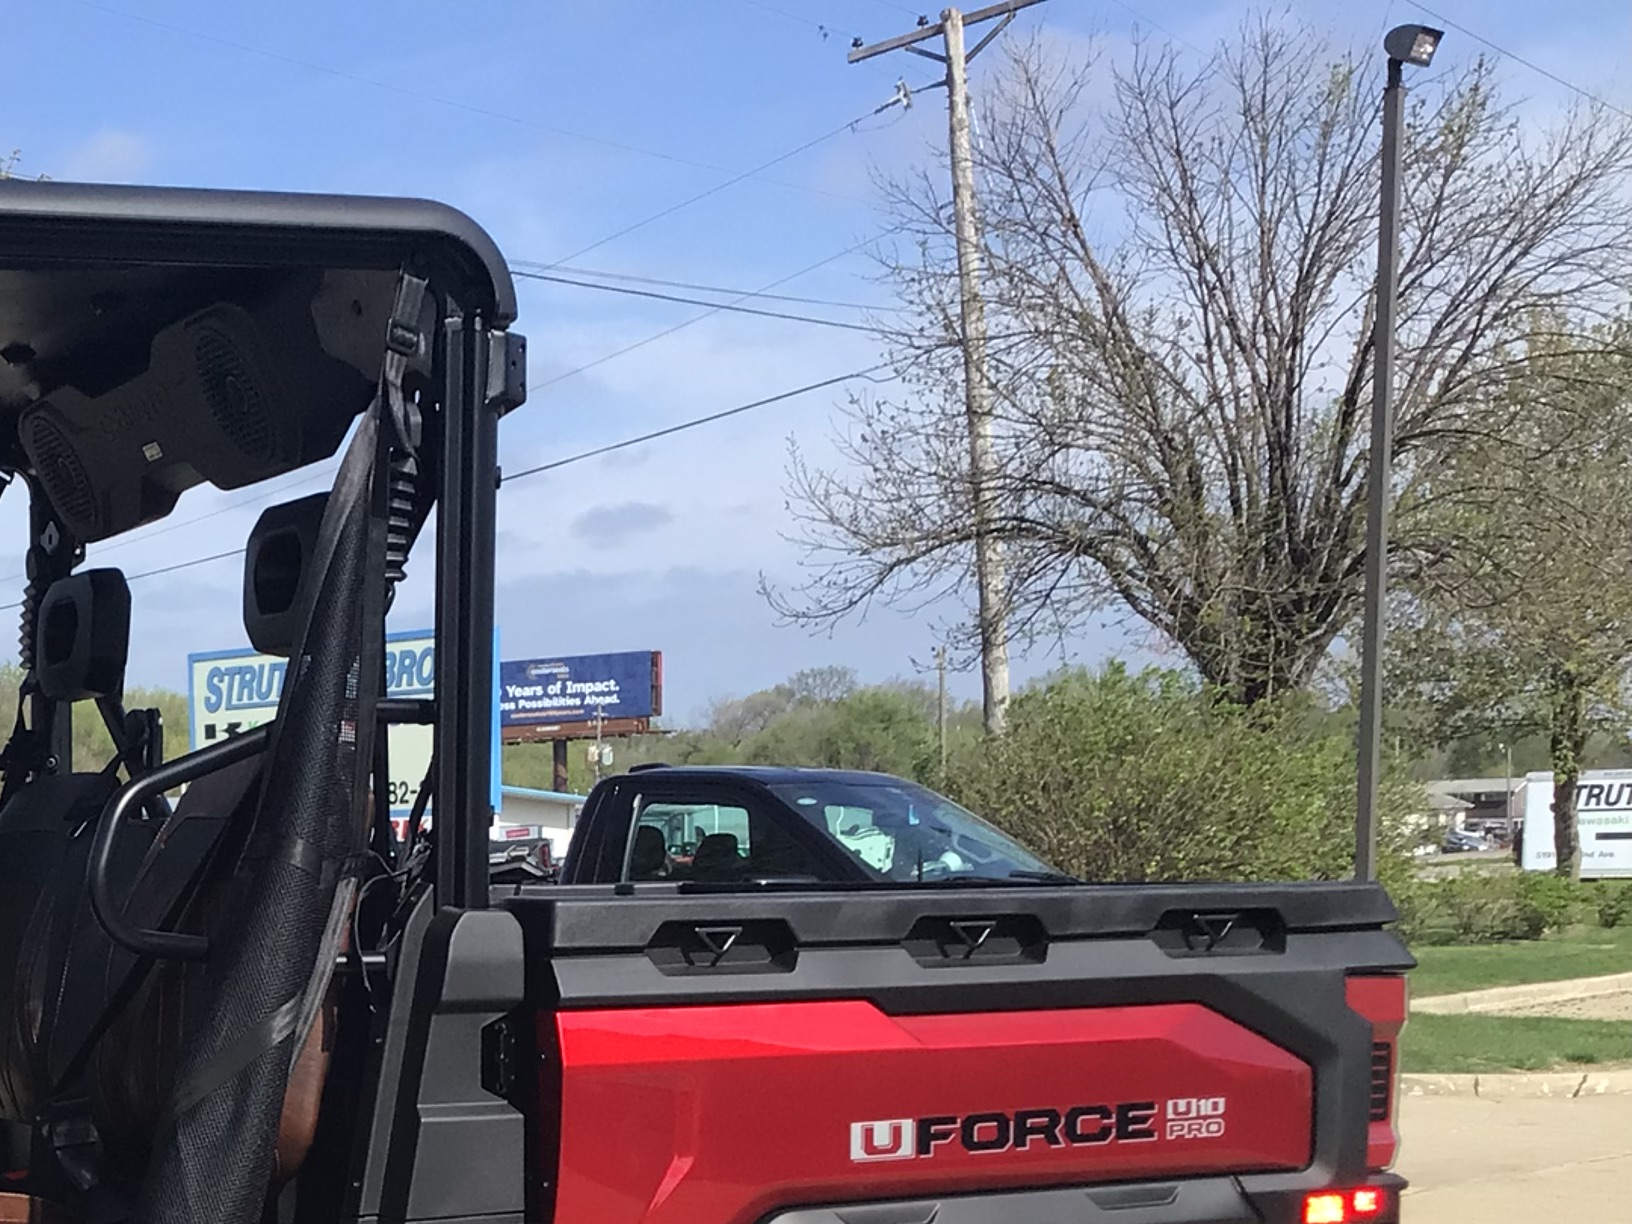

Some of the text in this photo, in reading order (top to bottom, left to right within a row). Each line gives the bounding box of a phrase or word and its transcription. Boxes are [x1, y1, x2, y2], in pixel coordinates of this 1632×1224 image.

[505, 679, 620, 698] Years of Impact.
[518, 696, 581, 709] Possibilities
[584, 693, 620, 706] Ahead.
[1165, 1118, 1226, 1141] PRO
